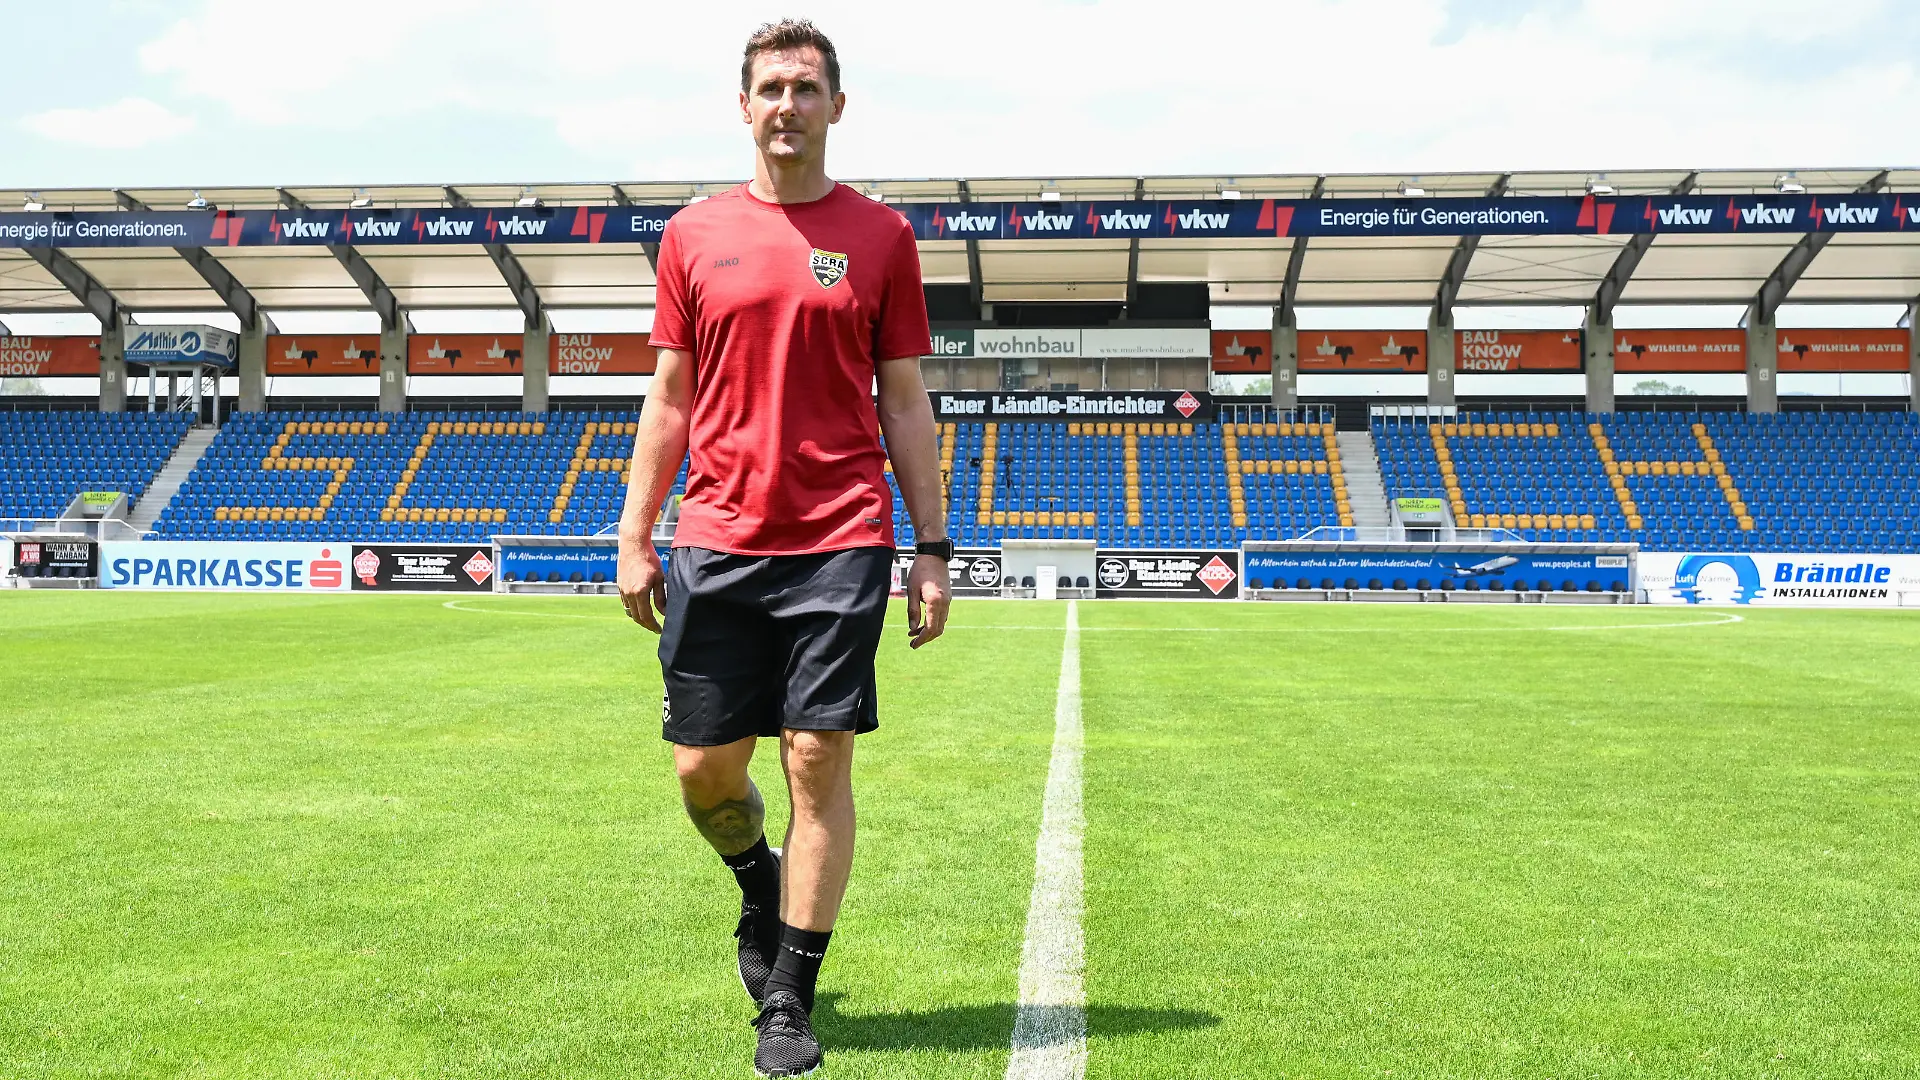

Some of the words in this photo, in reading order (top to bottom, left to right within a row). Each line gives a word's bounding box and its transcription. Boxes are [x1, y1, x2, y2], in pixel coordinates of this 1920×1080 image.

[1023, 210, 1073, 231] vkw
[1100, 209, 1151, 230] vkw
[1178, 208, 1229, 229] vkw
[1320, 208, 1389, 229] Energie
[1393, 207, 1417, 225] für
[1420, 207, 1549, 225] Generationen.
[1658, 203, 1712, 225] vkw
[1741, 203, 1795, 224] vkw
[1823, 202, 1878, 224] vkw
[52, 220, 74, 237] für
[76, 221, 187, 238] Generationen.
[282, 217, 329, 238] vkw
[354, 217, 400, 237] vkw
[426, 216, 473, 237] vkw
[498, 215, 546, 236] vkw
[946, 211, 996, 232] vkw
[713, 258, 740, 269] JAKO
[812, 255, 846, 271] SCRA
[0, 337, 32, 349] BAU
[558, 334, 592, 347] BAU
[980, 335, 1074, 354] wohnbau
[1462, 330, 1499, 344] BAU
[558, 347, 613, 361] KNOW
[1462, 344, 1522, 358] KNOW
[1648, 344, 1697, 353] WILHELM
[1703, 344, 1740, 353] MAYER
[1810, 344, 1860, 352] WILHELM
[1866, 344, 1904, 352] MAYER
[0, 350, 52, 362] KNOW
[0, 363, 40, 375] HOW
[558, 361, 600, 374] HOW
[1462, 358, 1509, 371] HOW
[940, 395, 985, 414] Euer
[991, 394, 1166, 414] Ländle-Einrichter
[46, 543, 68, 551] WANN
[77, 543, 88, 551] WO
[55, 551, 88, 560] FANBANK
[1261, 558, 1299, 567] Altenrhein
[1337, 558, 1359, 568] Ihrer
[1532, 560, 1591, 569] www.peoples.at
[112, 558, 303, 588] SPARKASSE
[1676, 574, 1694, 583] Luft
[1773, 562, 1891, 584] Brändle
[1773, 588, 1888, 598] INSTALLATIONEN
